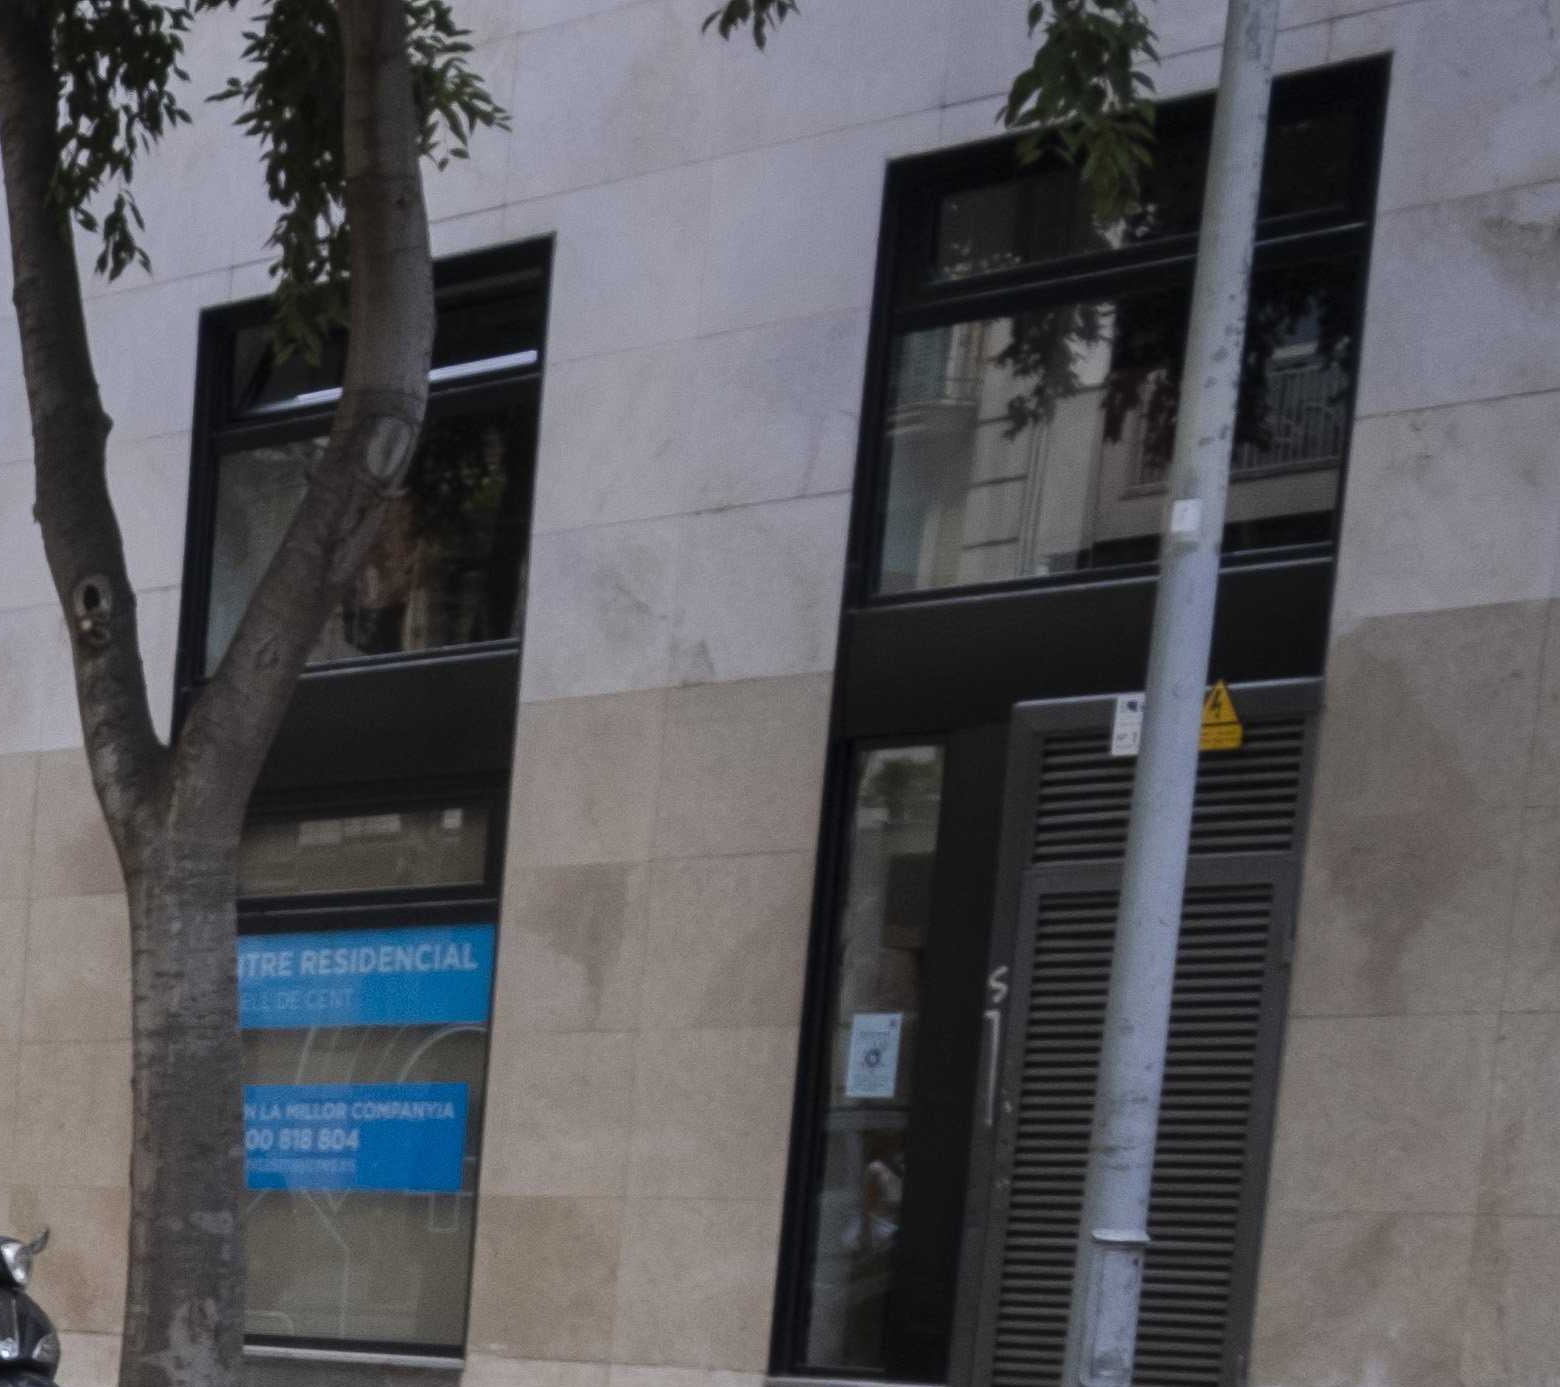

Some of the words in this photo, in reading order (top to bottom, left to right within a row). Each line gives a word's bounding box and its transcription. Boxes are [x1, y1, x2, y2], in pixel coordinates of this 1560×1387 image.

[299, 943, 479, 976] RESIDENCIAL
[351, 1101, 456, 1120] COMPANYIA
[317, 1127, 361, 1152] 804
